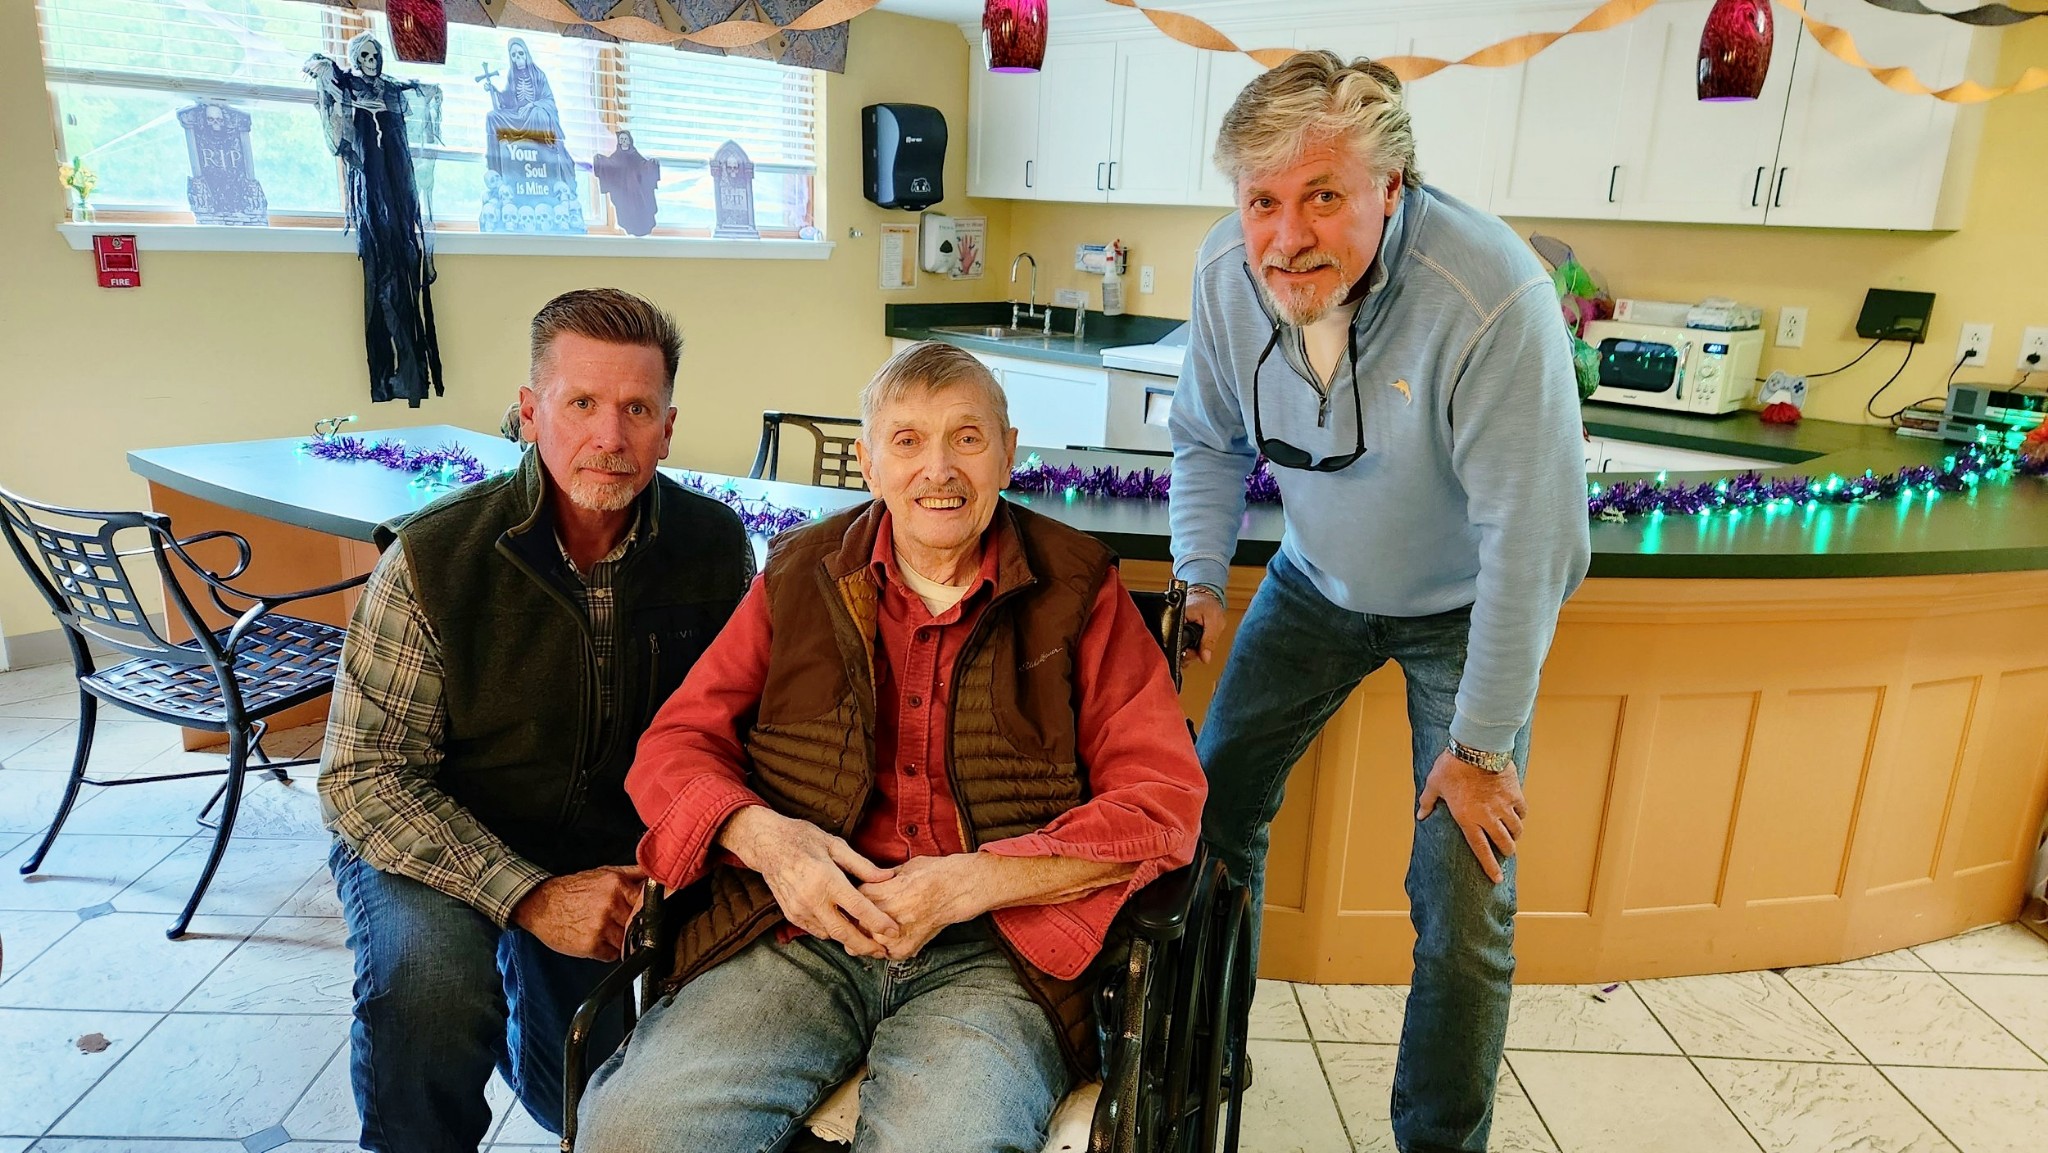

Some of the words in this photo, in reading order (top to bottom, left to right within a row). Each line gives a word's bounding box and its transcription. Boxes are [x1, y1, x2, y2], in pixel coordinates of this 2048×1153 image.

[202, 148, 241, 171] RIP
[506, 144, 538, 162] Your
[524, 163, 548, 178] Soul
[525, 182, 550, 195] Mine
[110, 278, 131, 286] FIRE
